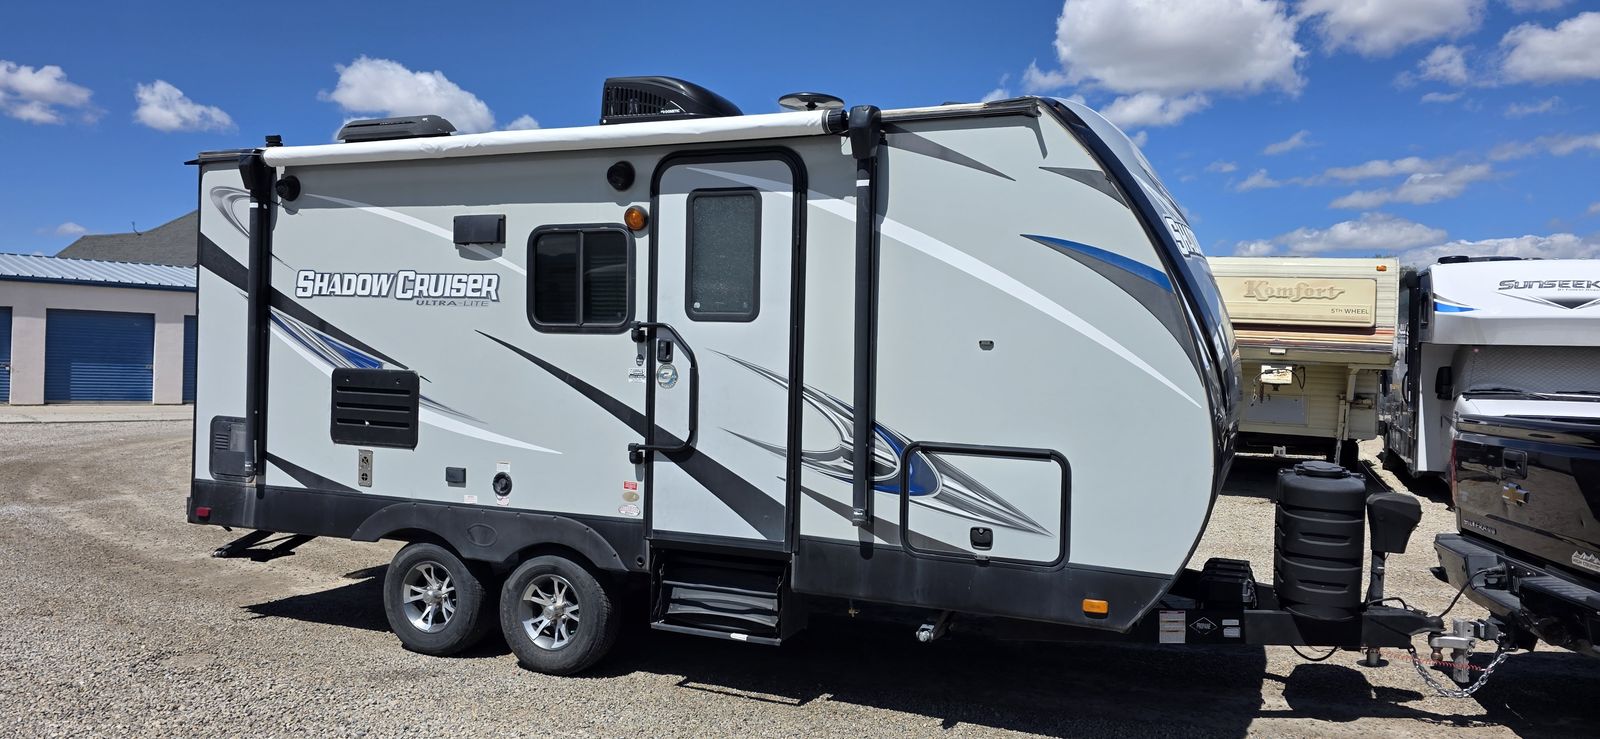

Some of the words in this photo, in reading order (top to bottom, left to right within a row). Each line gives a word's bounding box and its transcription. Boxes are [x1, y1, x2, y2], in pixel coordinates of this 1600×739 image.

[295, 269, 395, 299] SHADOW
[394, 269, 500, 302] CRUISER
[1243, 280, 1346, 302] Komfort
